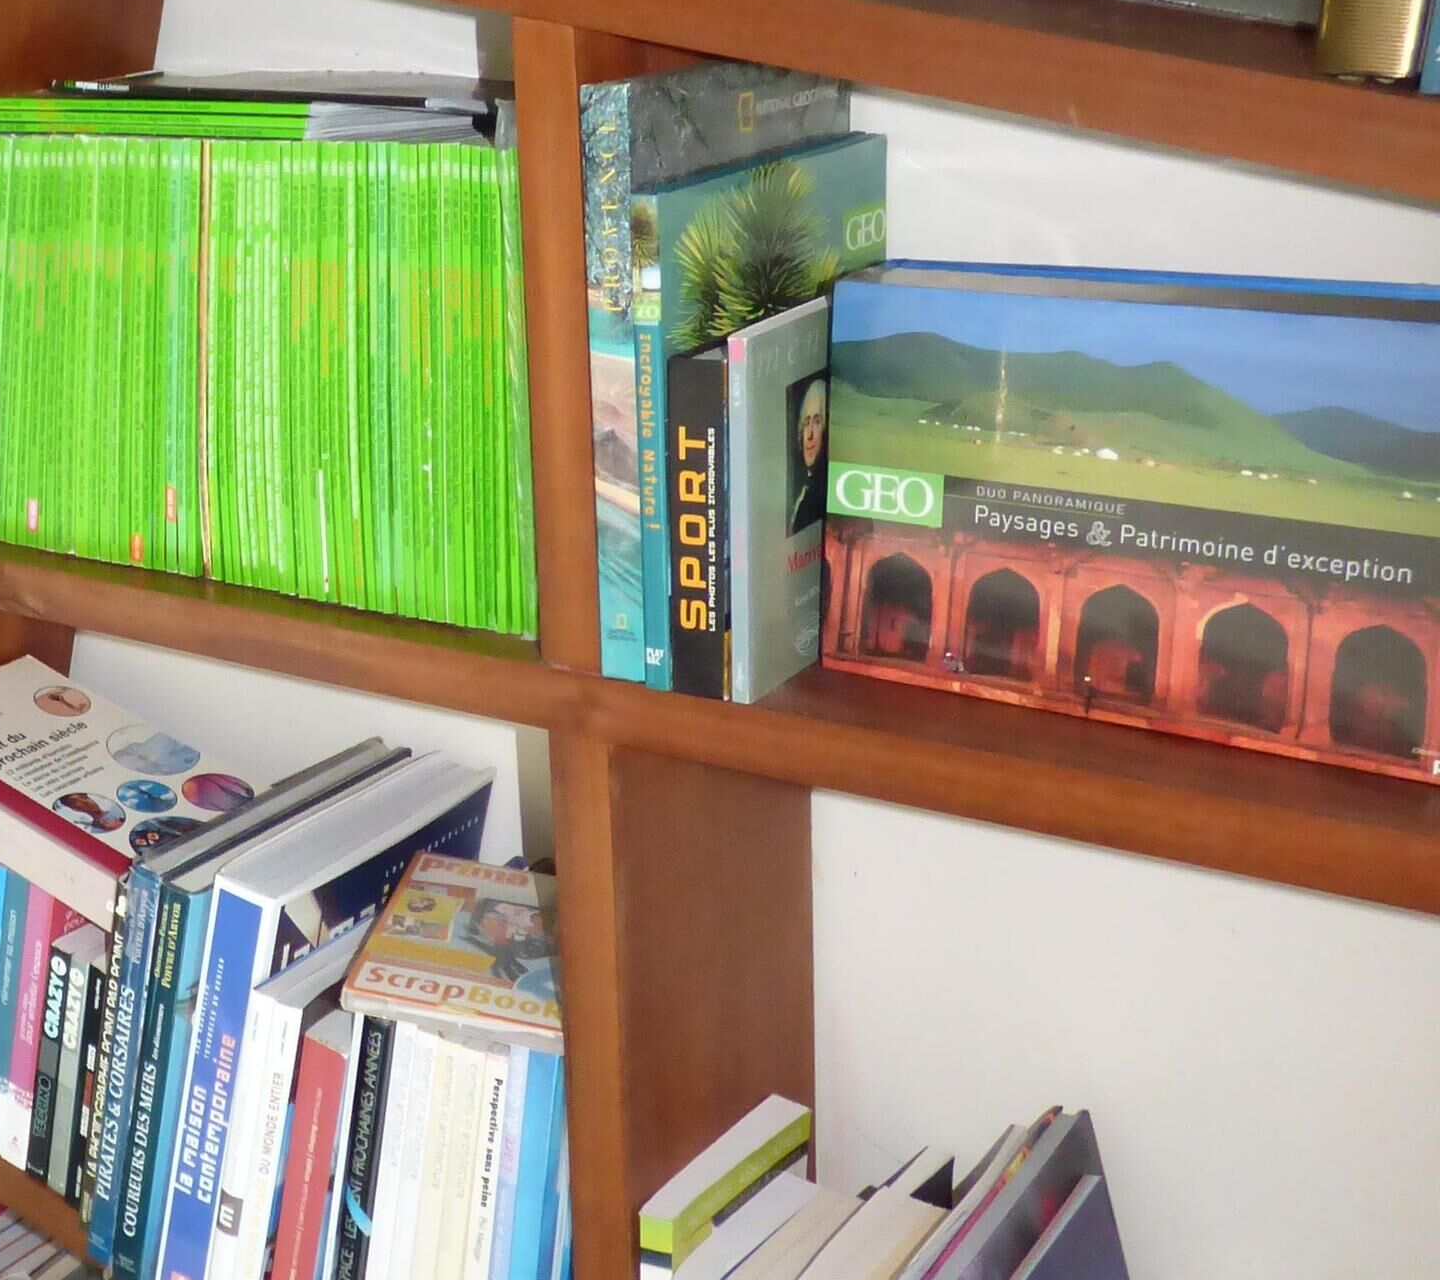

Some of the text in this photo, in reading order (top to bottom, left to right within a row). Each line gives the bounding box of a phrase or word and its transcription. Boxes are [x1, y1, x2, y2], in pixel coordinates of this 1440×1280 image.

[598, 118, 622, 313] PROVENCE
[845, 209, 886, 251] GEO
[642, 449, 657, 517] Nature
[835, 469, 936, 519] GEO
[975, 484, 1127, 518] DUO PANORAMIQUE
[678, 425, 708, 631] SPORT
[707, 427, 717, 631] LES PHOTOS LES PLUS INCROYABLES
[973, 504, 1415, 586] Paysages & Patrimoine d'exception
[7, 731, 27, 744] du
[48, 720, 88, 743] siècle
[419, 857, 529, 888] prima
[160, 902, 182, 989] POIVRE D'ARVOR
[44, 974, 63, 1039] CRAZY
[61, 988, 81, 1051] CRAZY
[87, 931, 125, 1160] PHOTOGRAPHIE POINT PAR POINT
[96, 985, 135, 1201] PIRATES & CORSAIRES
[361, 1031, 382, 1089] ANNEES
[33, 1074, 51, 1138] TECHNO
[173, 1084, 208, 1196] la maison
[196, 1032, 237, 1205] contemporaine
[258, 1071, 285, 1176] DU MONDE ENTIER
[351, 1091, 378, 1177] PROCHAINES
[479, 1077, 505, 1209] Perspective sans peine
[123, 1062, 158, 1237] COUREURS DES MERS
